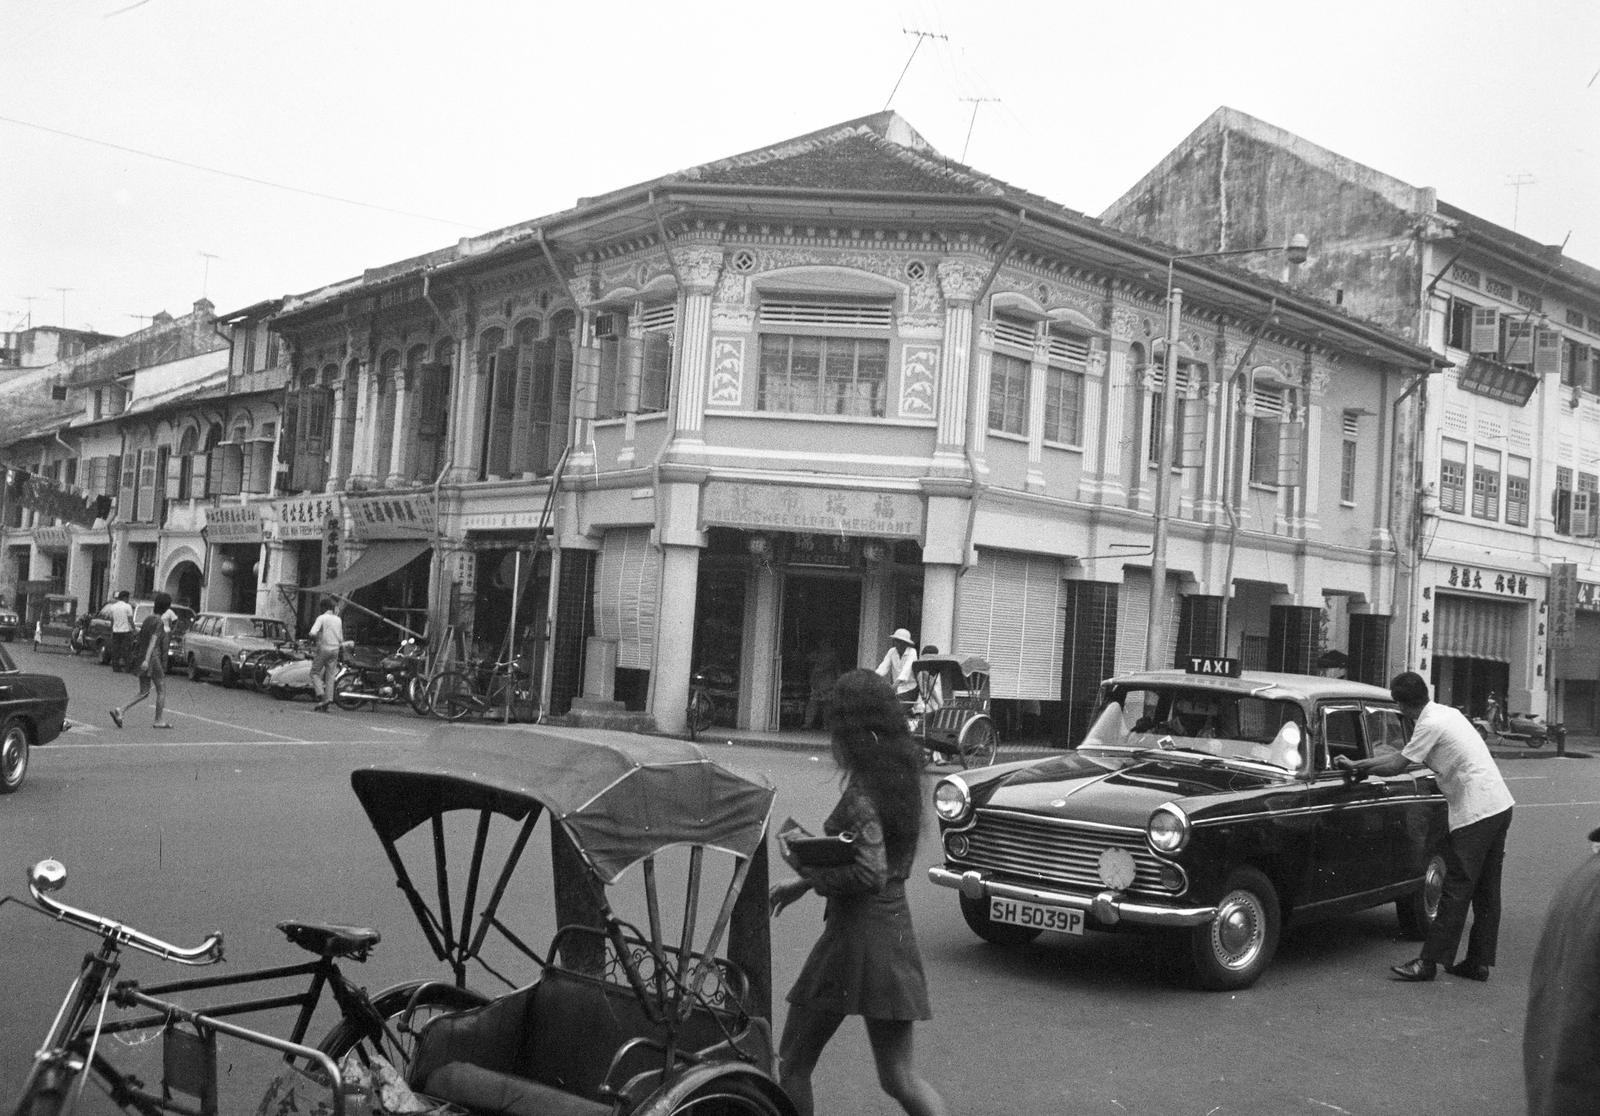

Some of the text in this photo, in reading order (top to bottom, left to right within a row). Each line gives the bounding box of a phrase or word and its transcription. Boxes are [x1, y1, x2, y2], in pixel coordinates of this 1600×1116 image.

[841, 518, 914, 533] MERCHANT
[1191, 658, 1230, 674] TAXI
[992, 901, 1081, 932] SH 5039P
